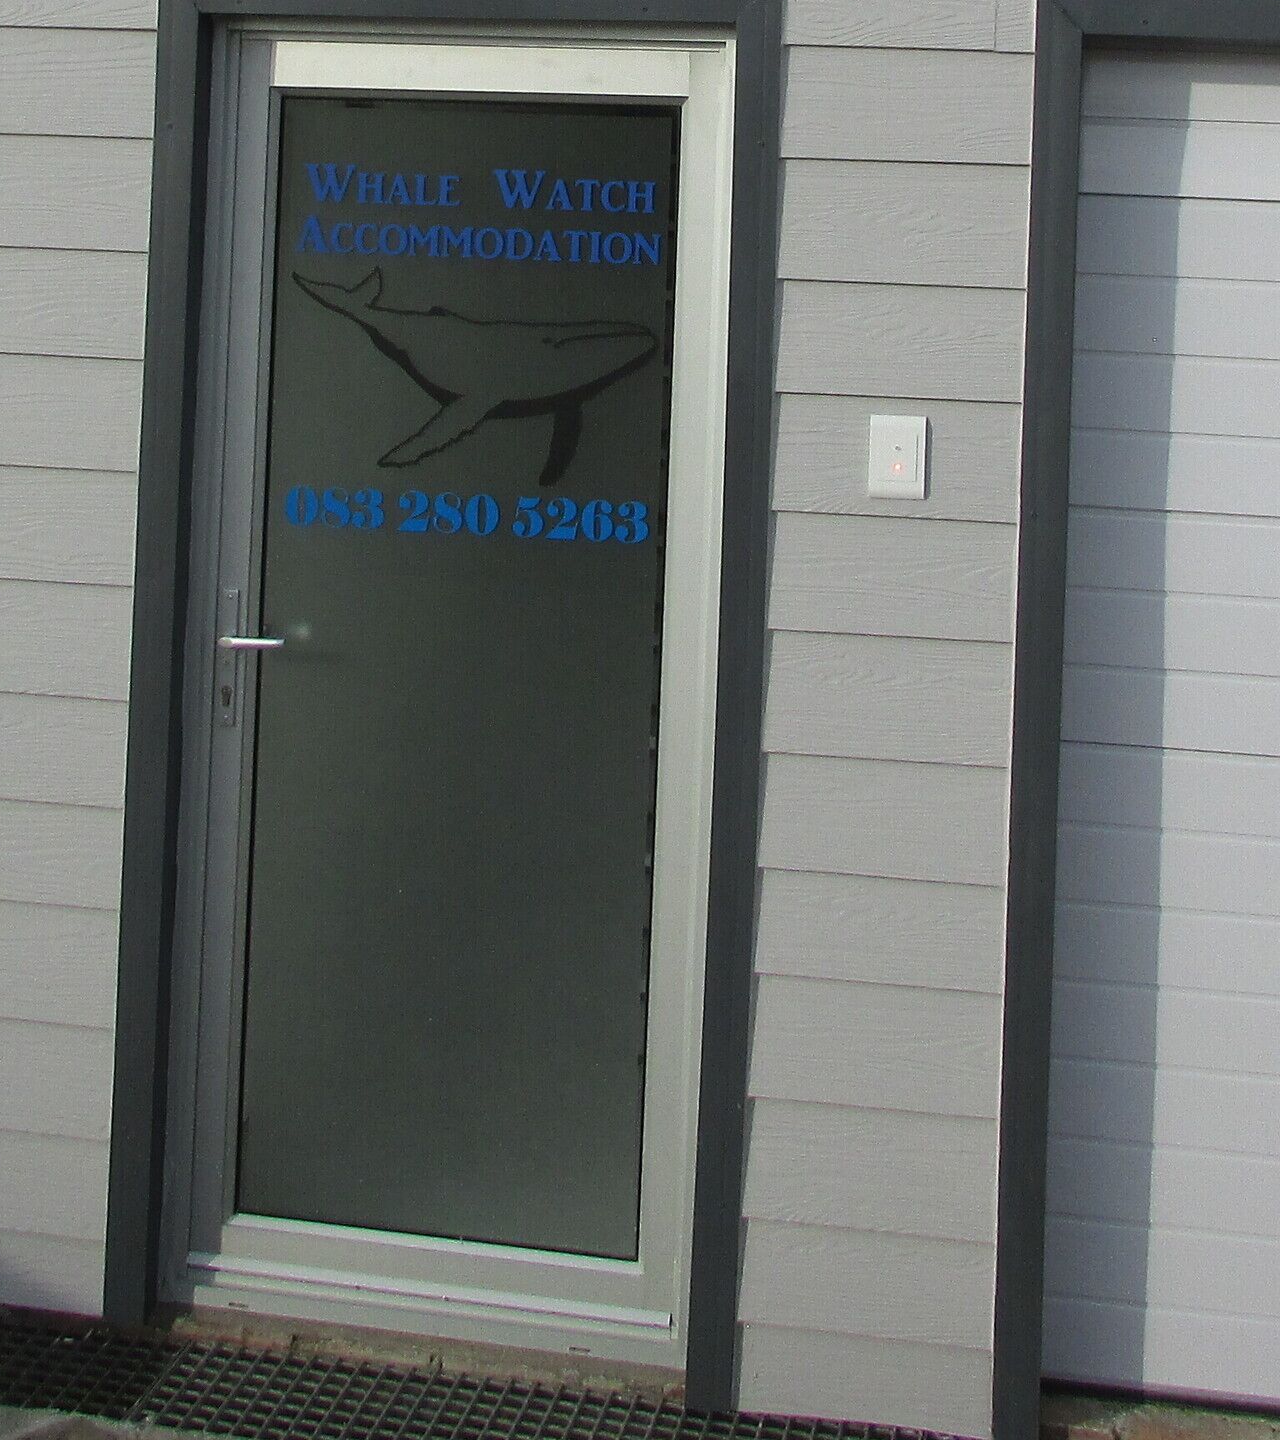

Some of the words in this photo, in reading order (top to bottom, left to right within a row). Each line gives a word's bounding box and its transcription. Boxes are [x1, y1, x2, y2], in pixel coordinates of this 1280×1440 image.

[305, 163, 460, 207] WHALE
[493, 169, 656, 213] WATCH
[296, 215, 662, 265] ACCOMMODATION
[285, 485, 385, 531] 083
[397, 489, 500, 536] 280
[512, 495, 650, 544] 5263
